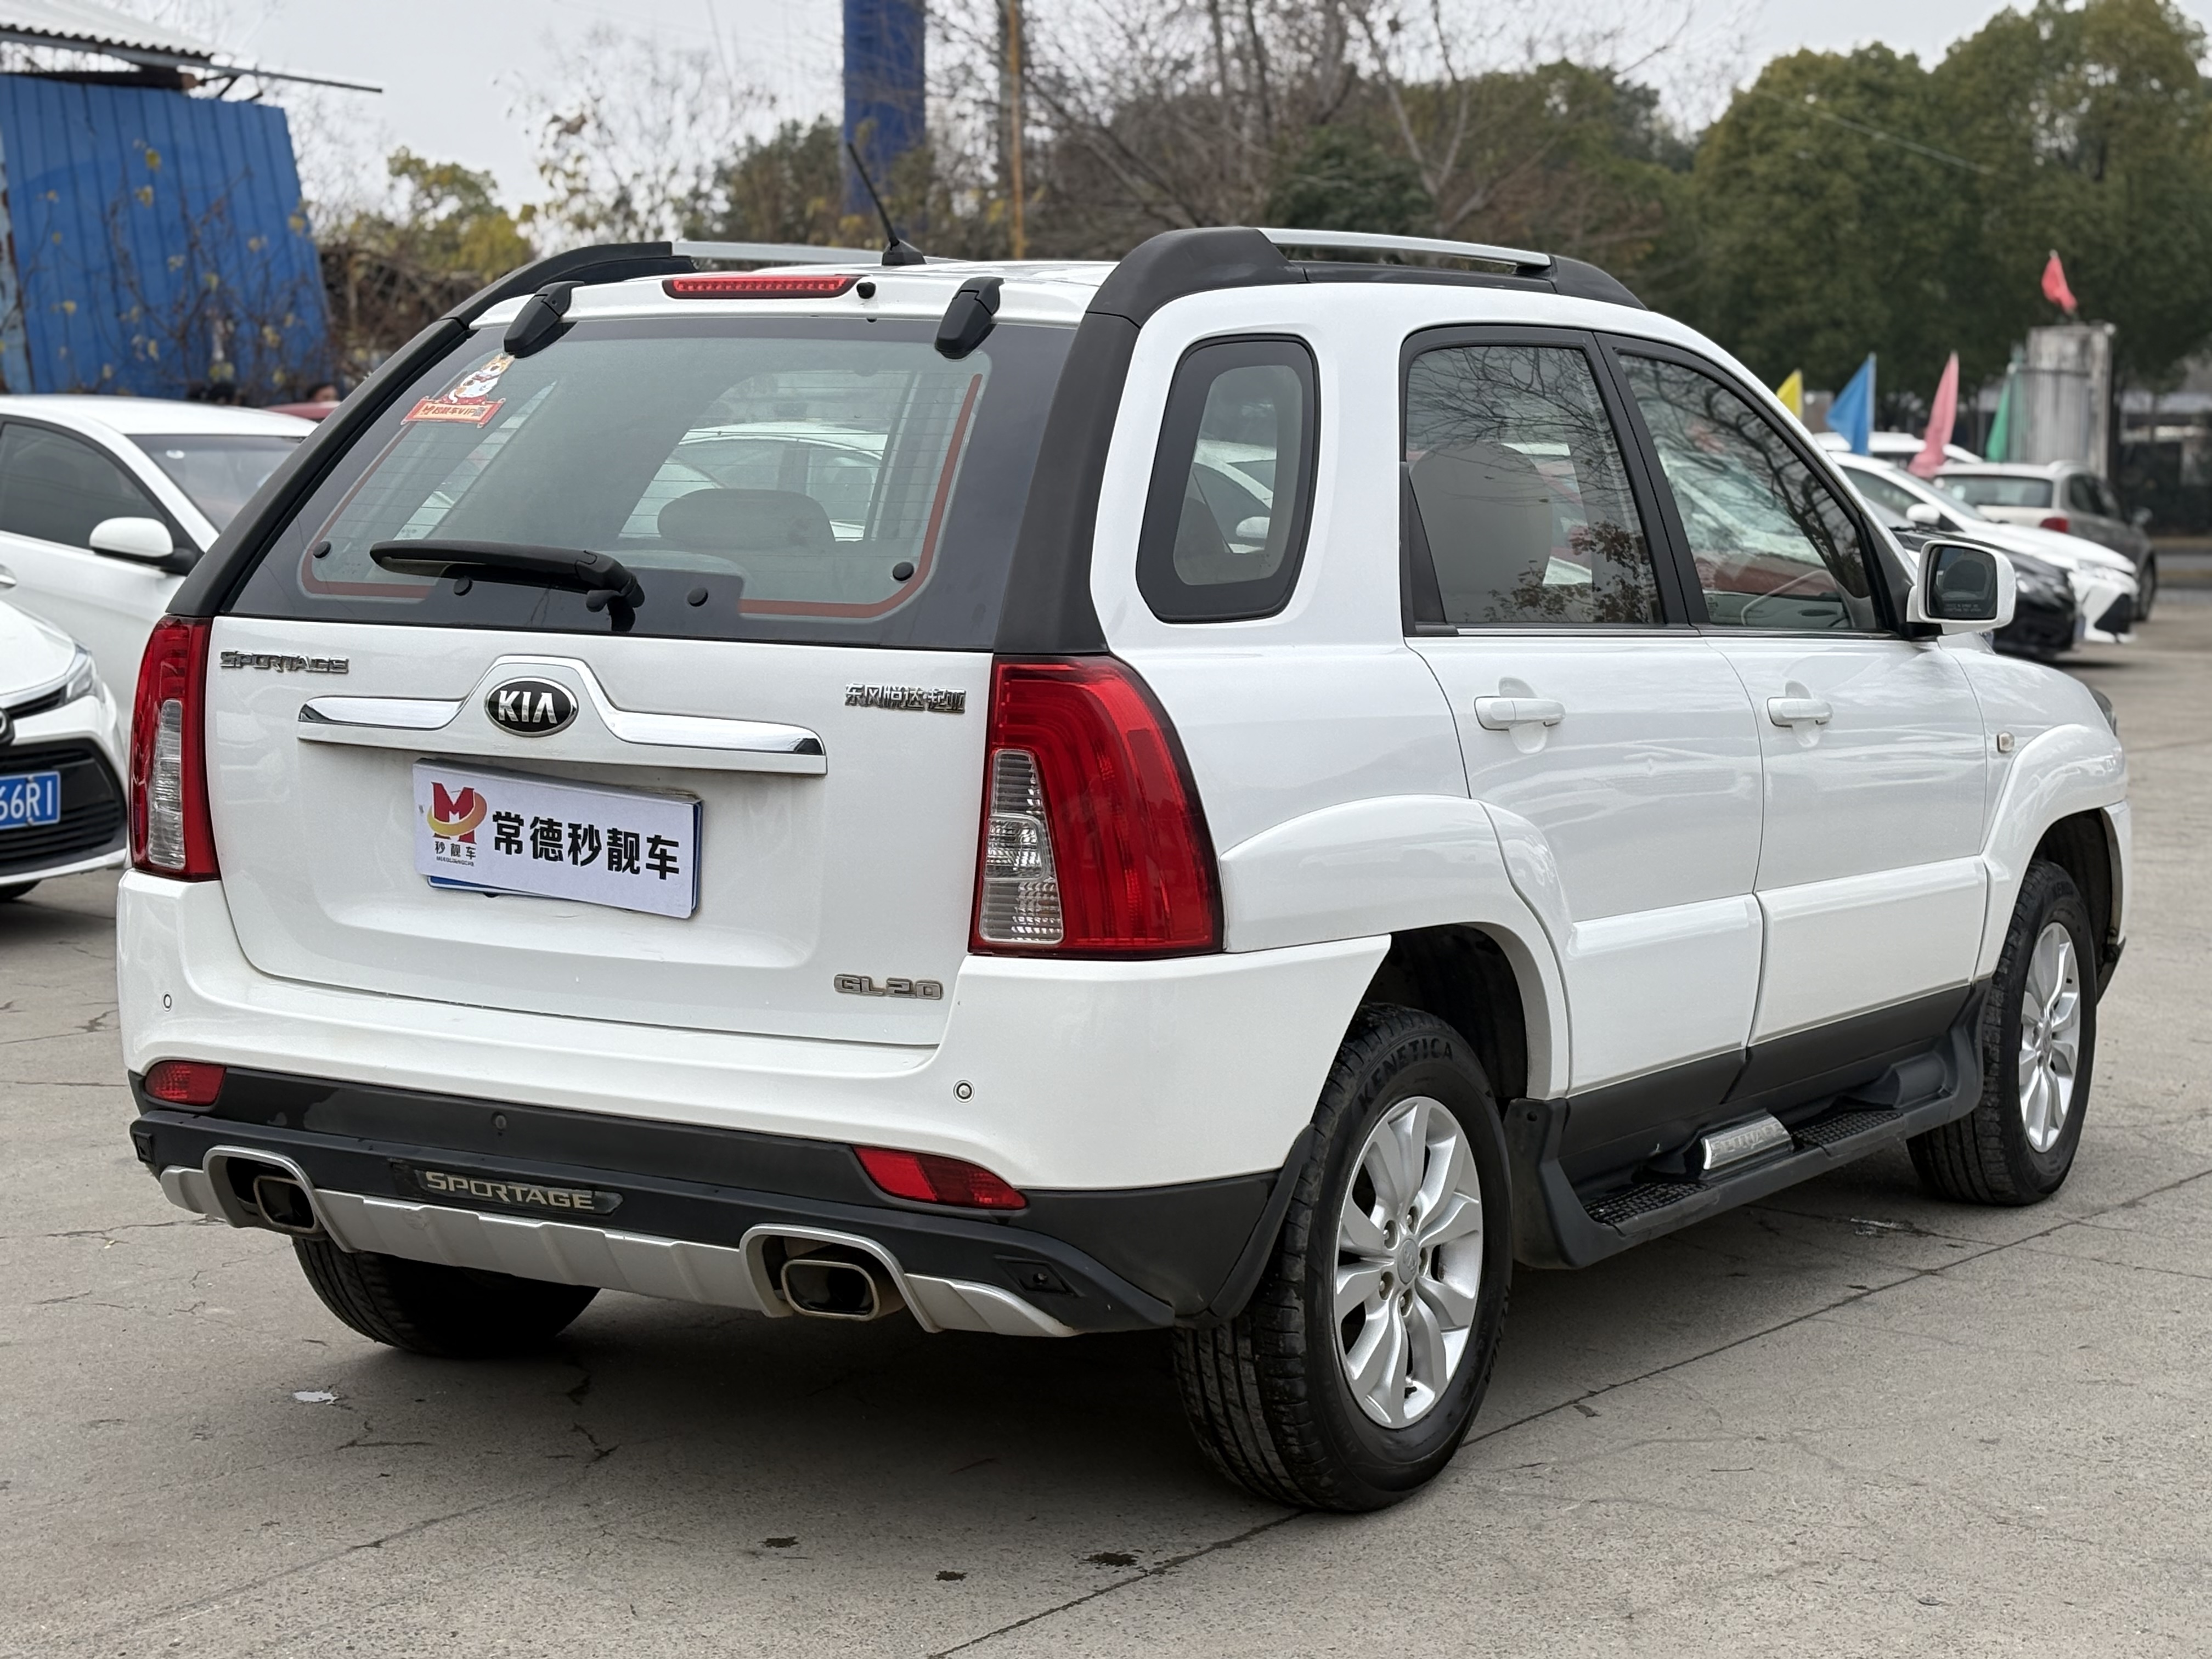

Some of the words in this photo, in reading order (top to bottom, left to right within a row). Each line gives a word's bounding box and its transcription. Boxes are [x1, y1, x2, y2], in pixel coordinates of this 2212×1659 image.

[219, 650, 348, 674] SPORTAGE
[498, 690, 557, 724] KIA
[435, 841, 476, 860] 秒靓车
[493, 811, 680, 881] 常德秒靓车
[1357, 1037, 1453, 1113] KENETICA
[426, 1171, 595, 1210] SPORTAGE
